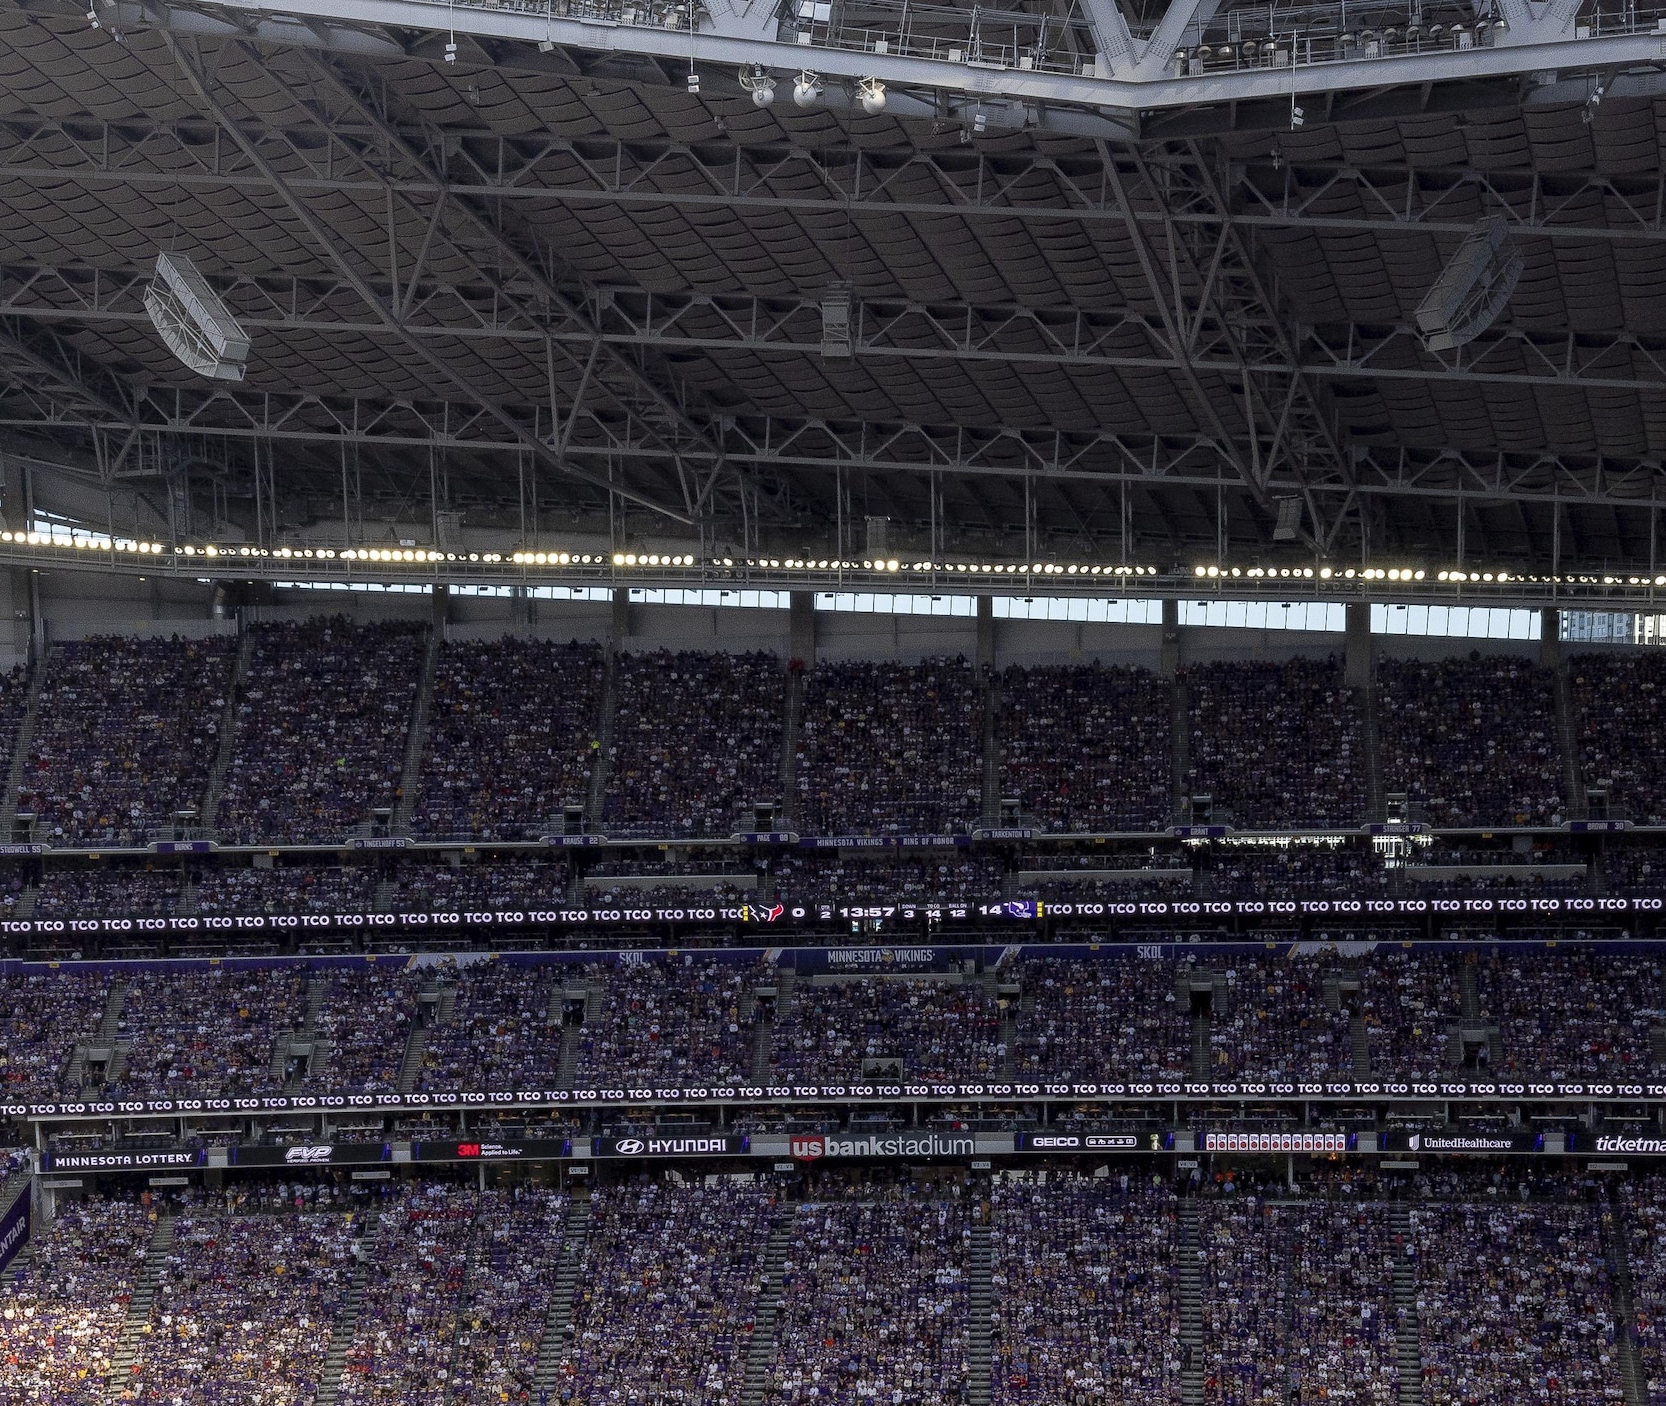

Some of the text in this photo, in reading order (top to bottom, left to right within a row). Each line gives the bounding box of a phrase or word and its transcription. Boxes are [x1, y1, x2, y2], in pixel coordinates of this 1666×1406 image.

[589, 837, 599, 845] 22
[816, 837, 955, 847] MINNESOTA VIKINGS RING OF HONOR
[839, 907, 896, 918] 13:57
[979, 905, 1003, 916] 14
[1075, 903, 1104, 915] TCO
[1267, 901, 1297, 912] TCO
[1397, 900, 1427, 911] TCO
[1564, 898, 1595, 910] TCO
[792, 907, 806, 919] 0
[820, 911, 832, 919] 2
[903, 909, 915, 918] 3
[925, 909, 942, 919] 14
[949, 909, 967, 918] 12
[101, 919, 132, 930] TCO
[463, 912, 493, 923] TCO
[592, 909, 621, 921] TCO
[828, 949, 933, 964] MINNESOTA VIKINGS
[1136, 945, 1165, 960] SKOL
[648, 1139, 727, 1153] HYUNDAI
[1033, 1136, 1079, 1147] GEICO
[1424, 1137, 1513, 1149] UnitedHealthcare
[285, 1145, 333, 1160] FVP
[456, 1142, 480, 1157] 3M
[55, 1155, 132, 1167] MINNESOTA
